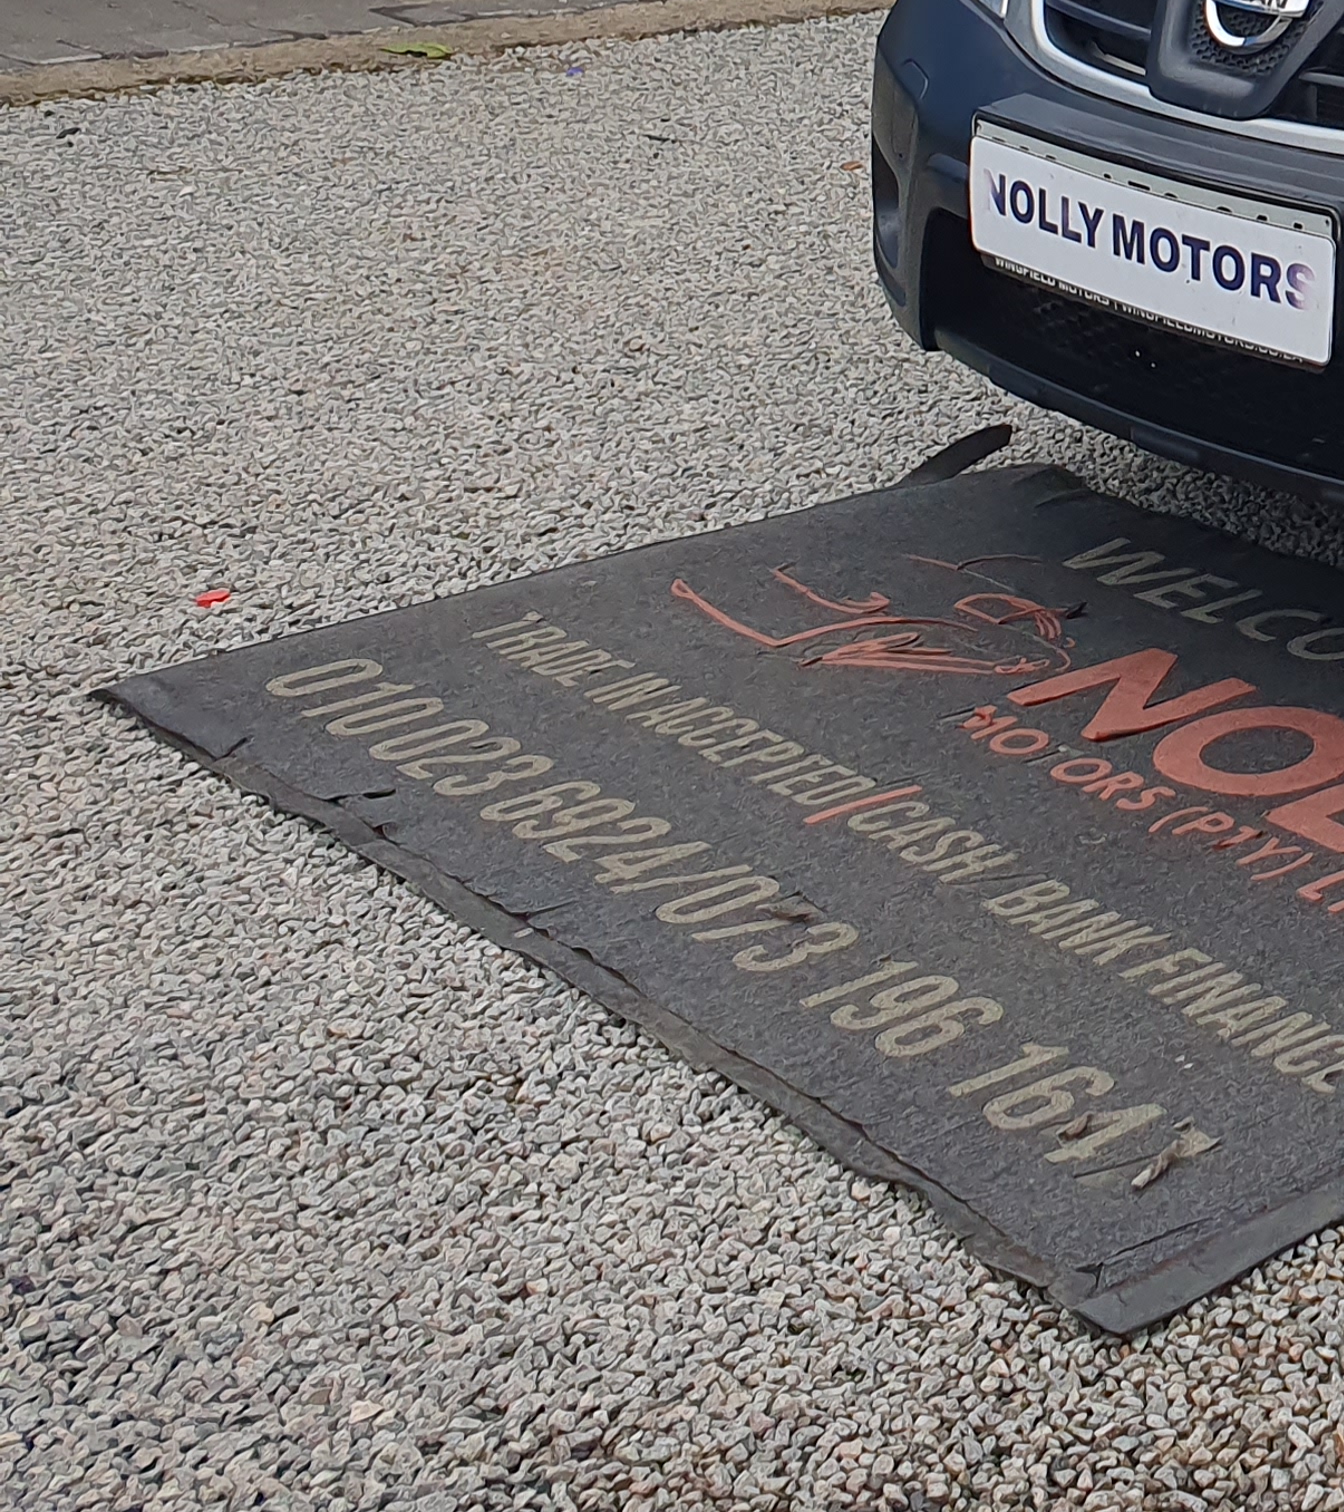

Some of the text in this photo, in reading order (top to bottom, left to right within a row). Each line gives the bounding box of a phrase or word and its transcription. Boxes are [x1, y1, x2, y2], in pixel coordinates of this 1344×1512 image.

[984, 168, 1315, 312] NOLLY MOTORS
[995, 256, 1056, 286] WINGFIELD
[472, 611, 636, 687] TRADE
[583, 671, 682, 711] IN
[956, 705, 1176, 811] MOORS
[1148, 806, 1315, 882] (PTY)
[800, 956, 1004, 1057] 196
